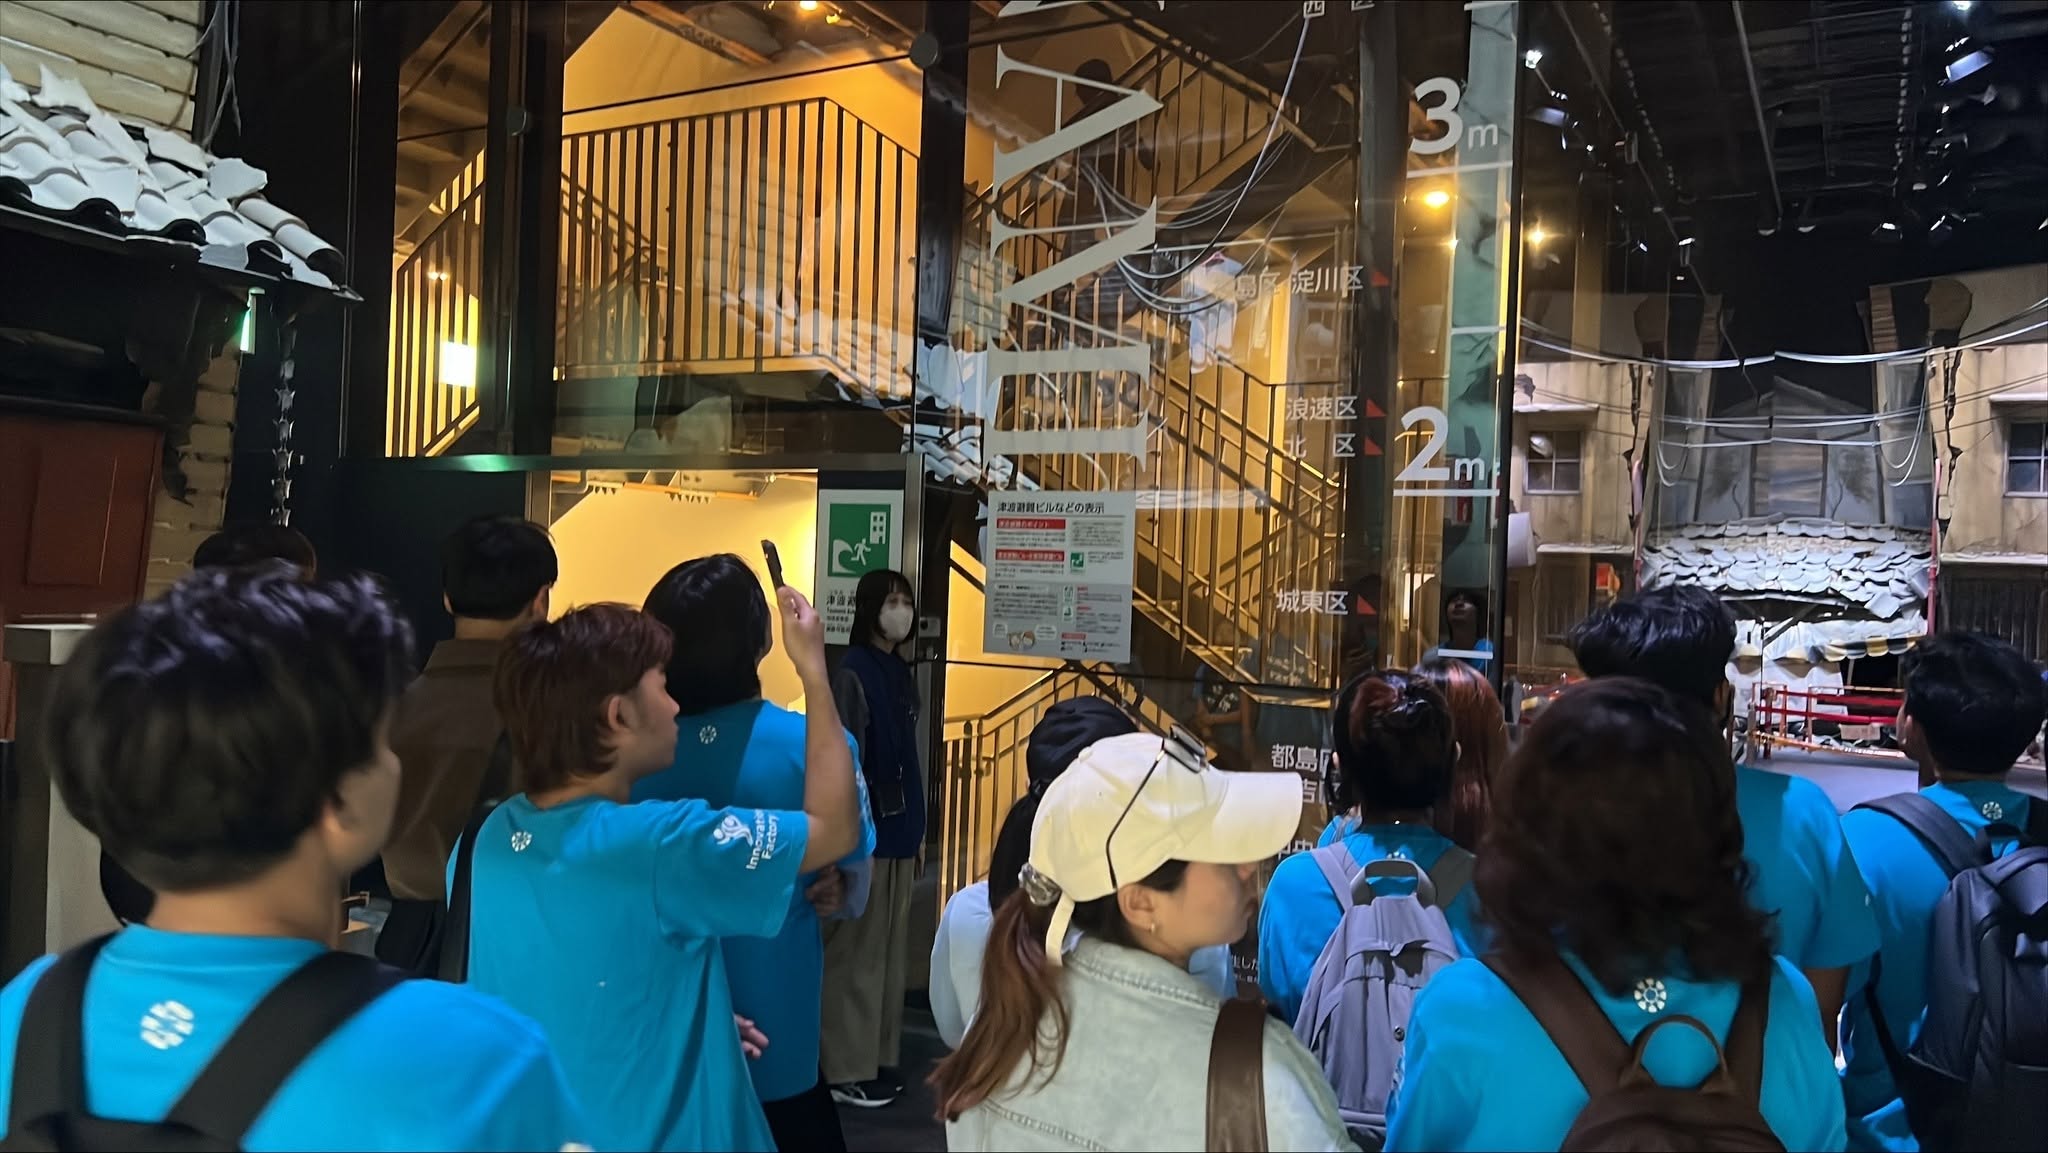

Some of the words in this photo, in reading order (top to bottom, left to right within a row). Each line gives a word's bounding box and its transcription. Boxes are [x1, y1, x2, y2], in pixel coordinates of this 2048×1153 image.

[983, 0, 1166, 473] AMI
[1292, 265, 1364, 295] 淀川区
[1286, 396, 1357, 421] 浪速区
[1394, 406, 1486, 481] 2m
[1276, 587, 1348, 615] 城東区
